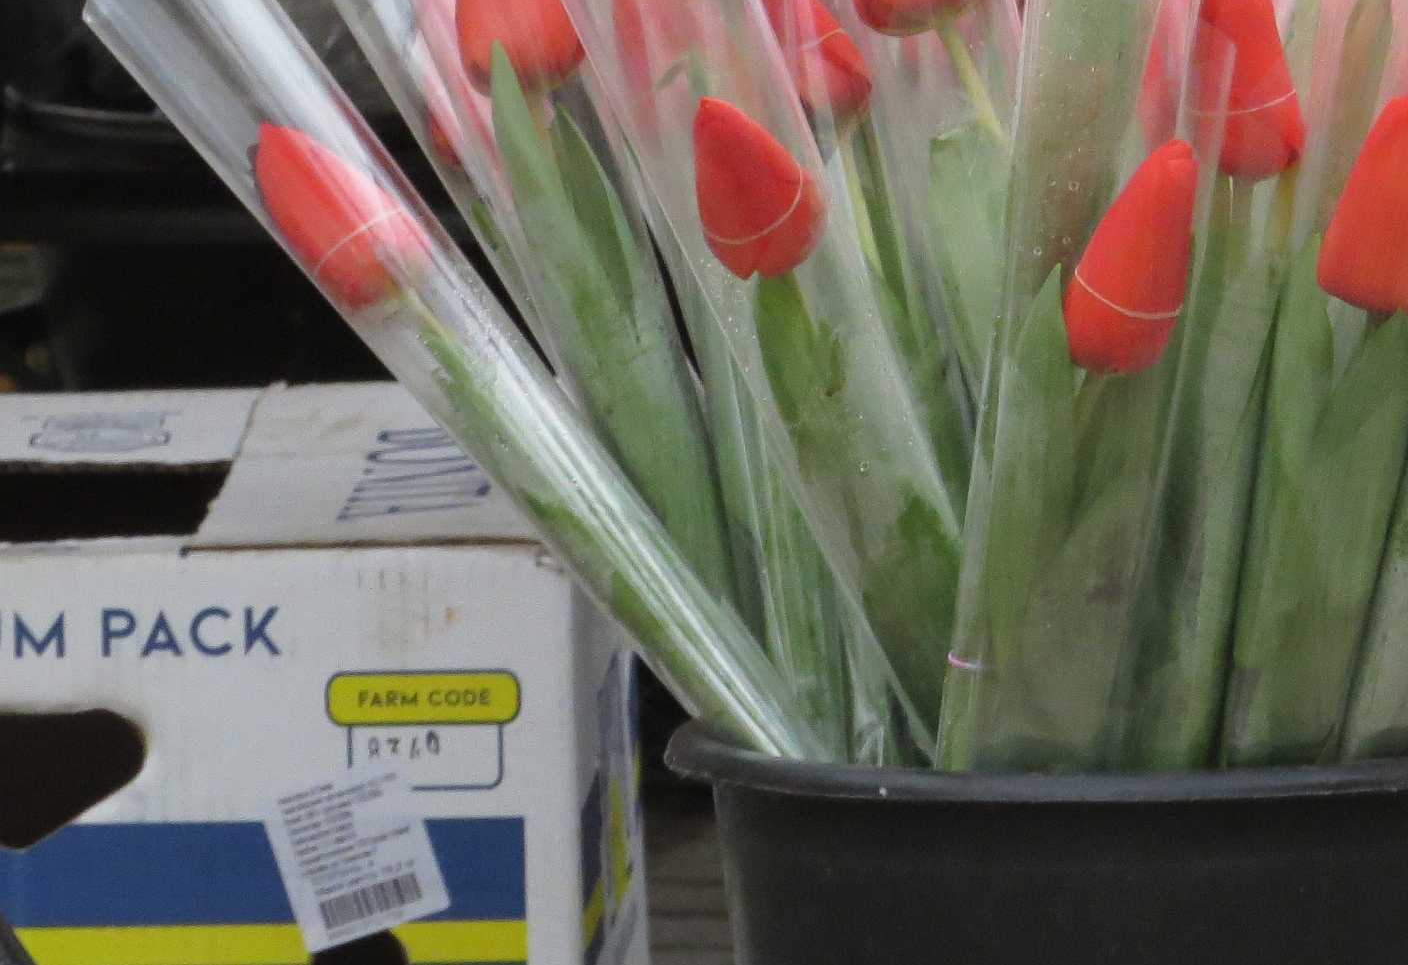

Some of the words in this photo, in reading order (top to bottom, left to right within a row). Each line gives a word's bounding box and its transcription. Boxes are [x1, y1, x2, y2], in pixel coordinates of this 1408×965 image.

[0, 608, 65, 658] M
[101, 605, 280, 658] PACK
[357, 689, 419, 708] FARM
[427, 687, 492, 707] CODE
